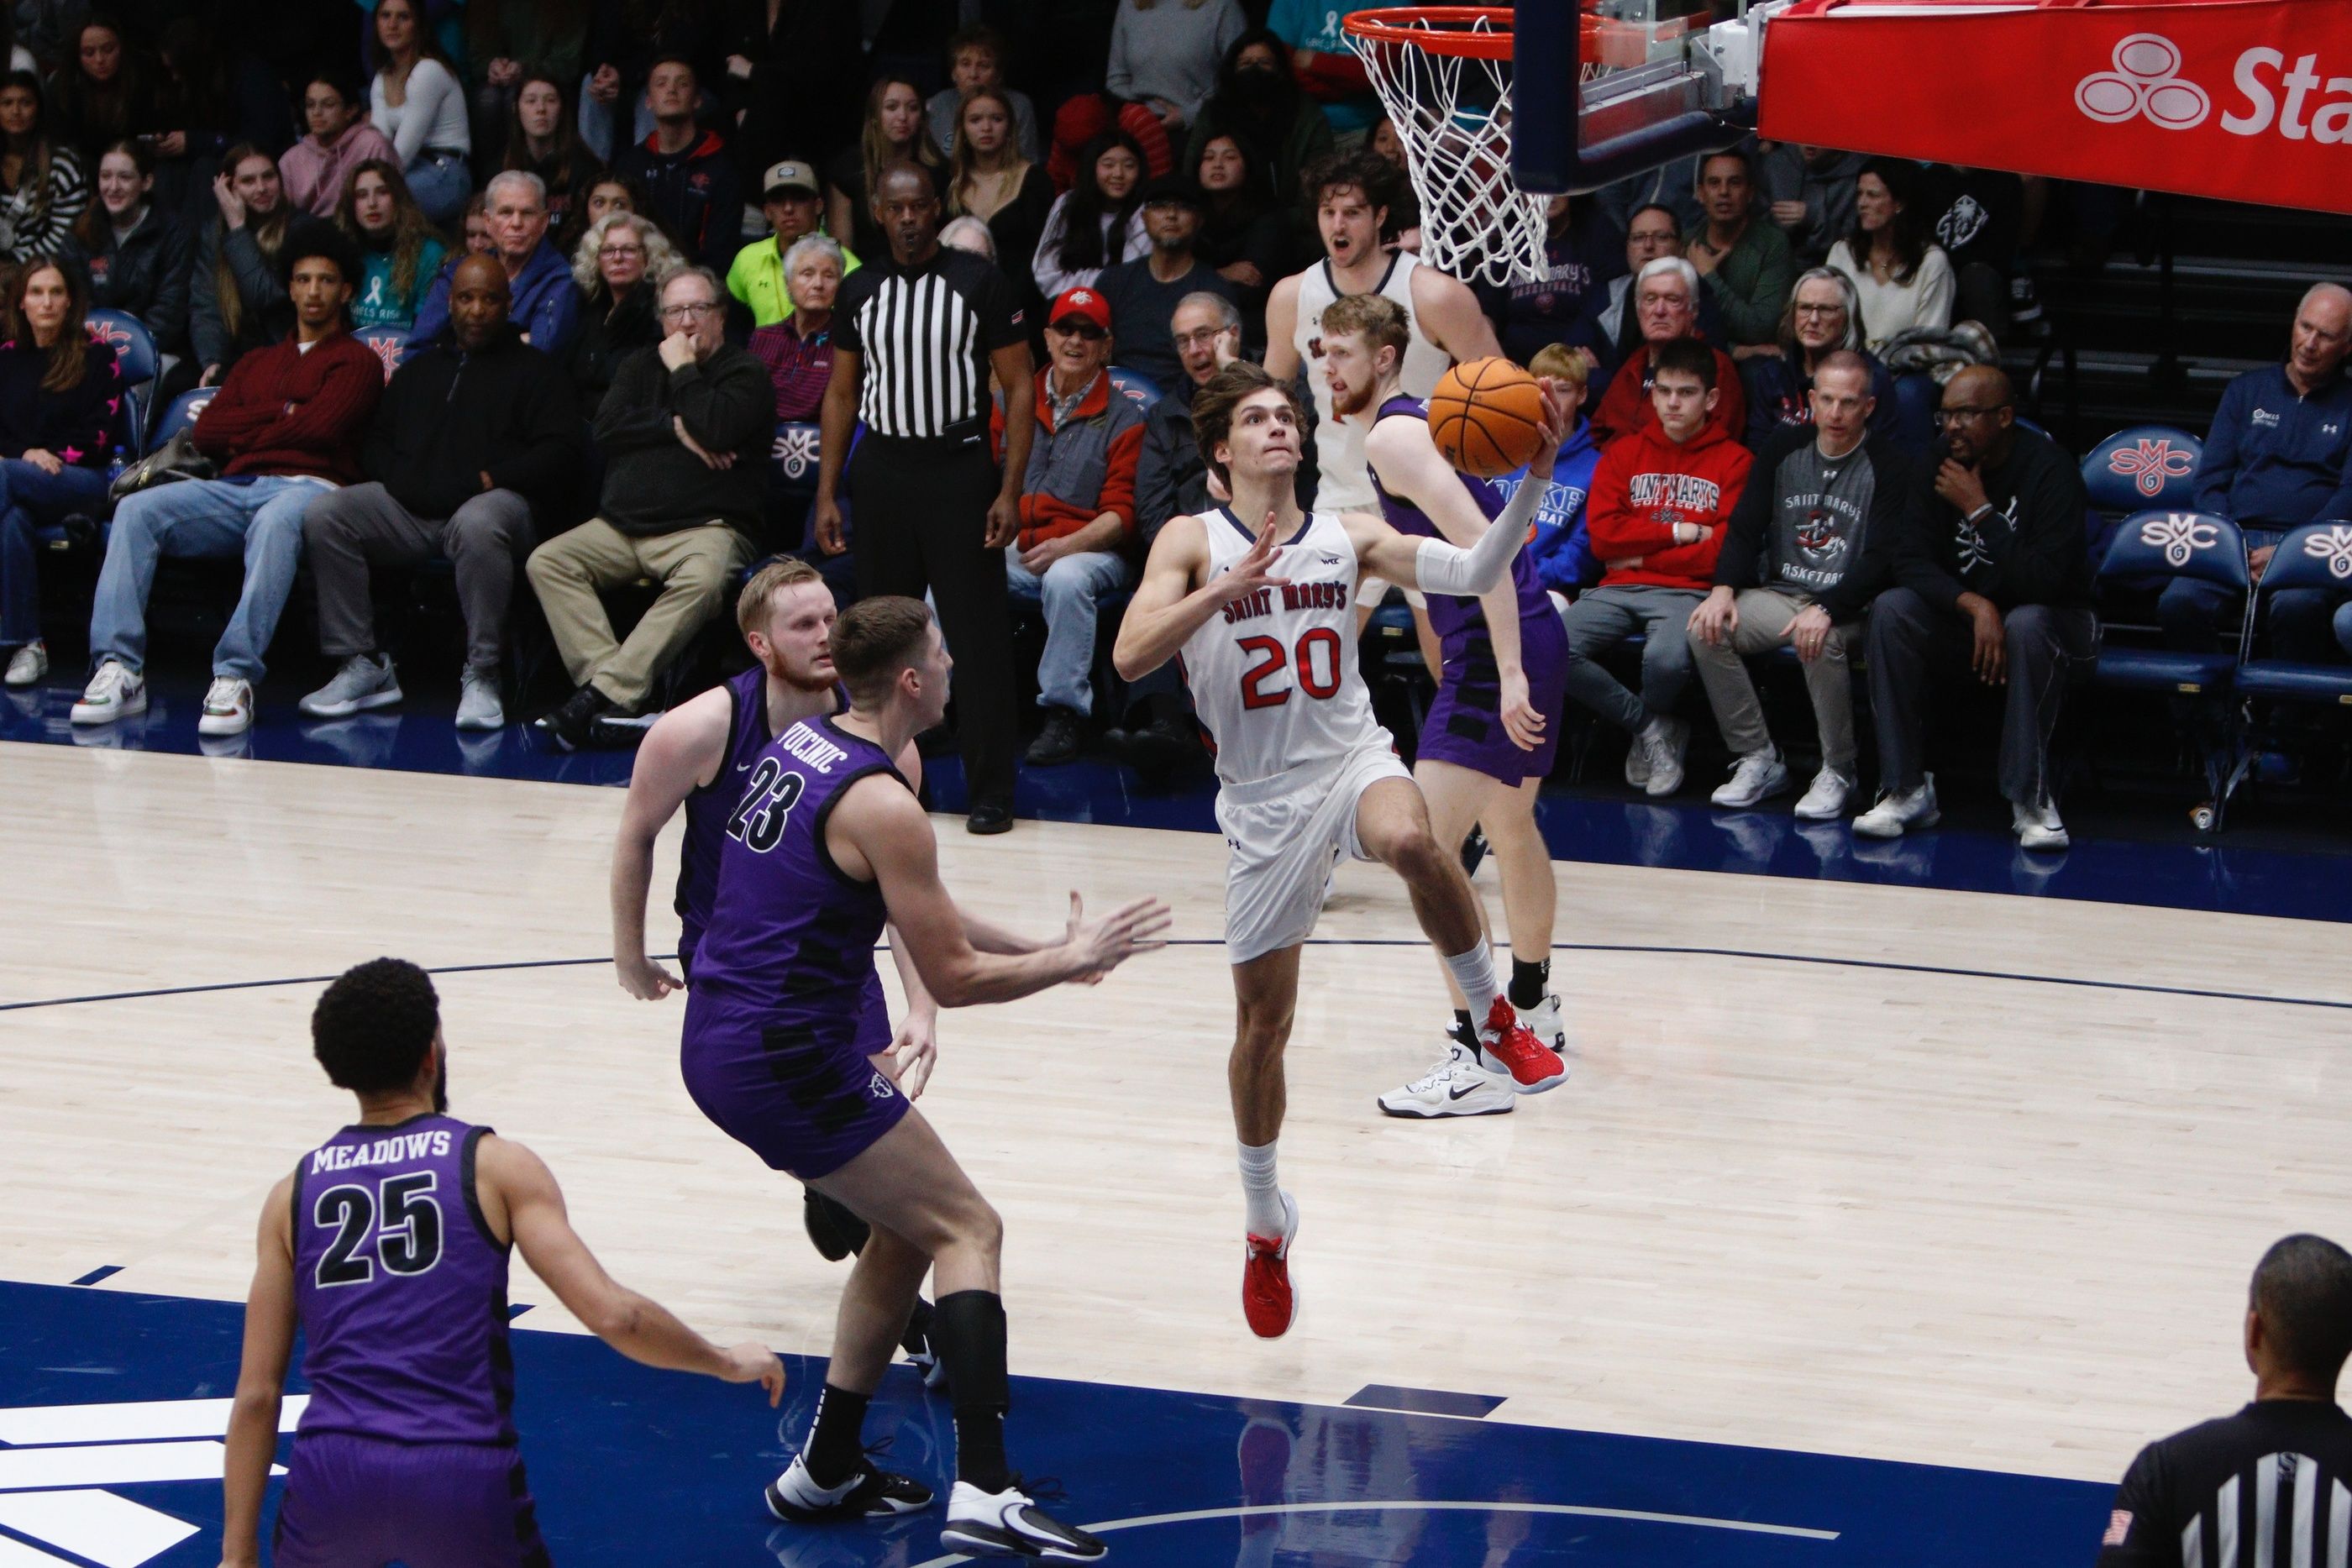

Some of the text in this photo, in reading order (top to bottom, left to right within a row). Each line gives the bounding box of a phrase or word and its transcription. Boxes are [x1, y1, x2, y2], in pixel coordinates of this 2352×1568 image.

[2108, 438, 2193, 497] SMC
[2141, 513, 2219, 568] SMC
[1280, 580, 1348, 611] MARY'S
[1236, 627, 1342, 711] 20
[777, 721, 848, 774] VUCINIC
[726, 756, 806, 854] 23
[311, 1130, 452, 1175] MEADOWS
[314, 1169, 444, 1290] 25
